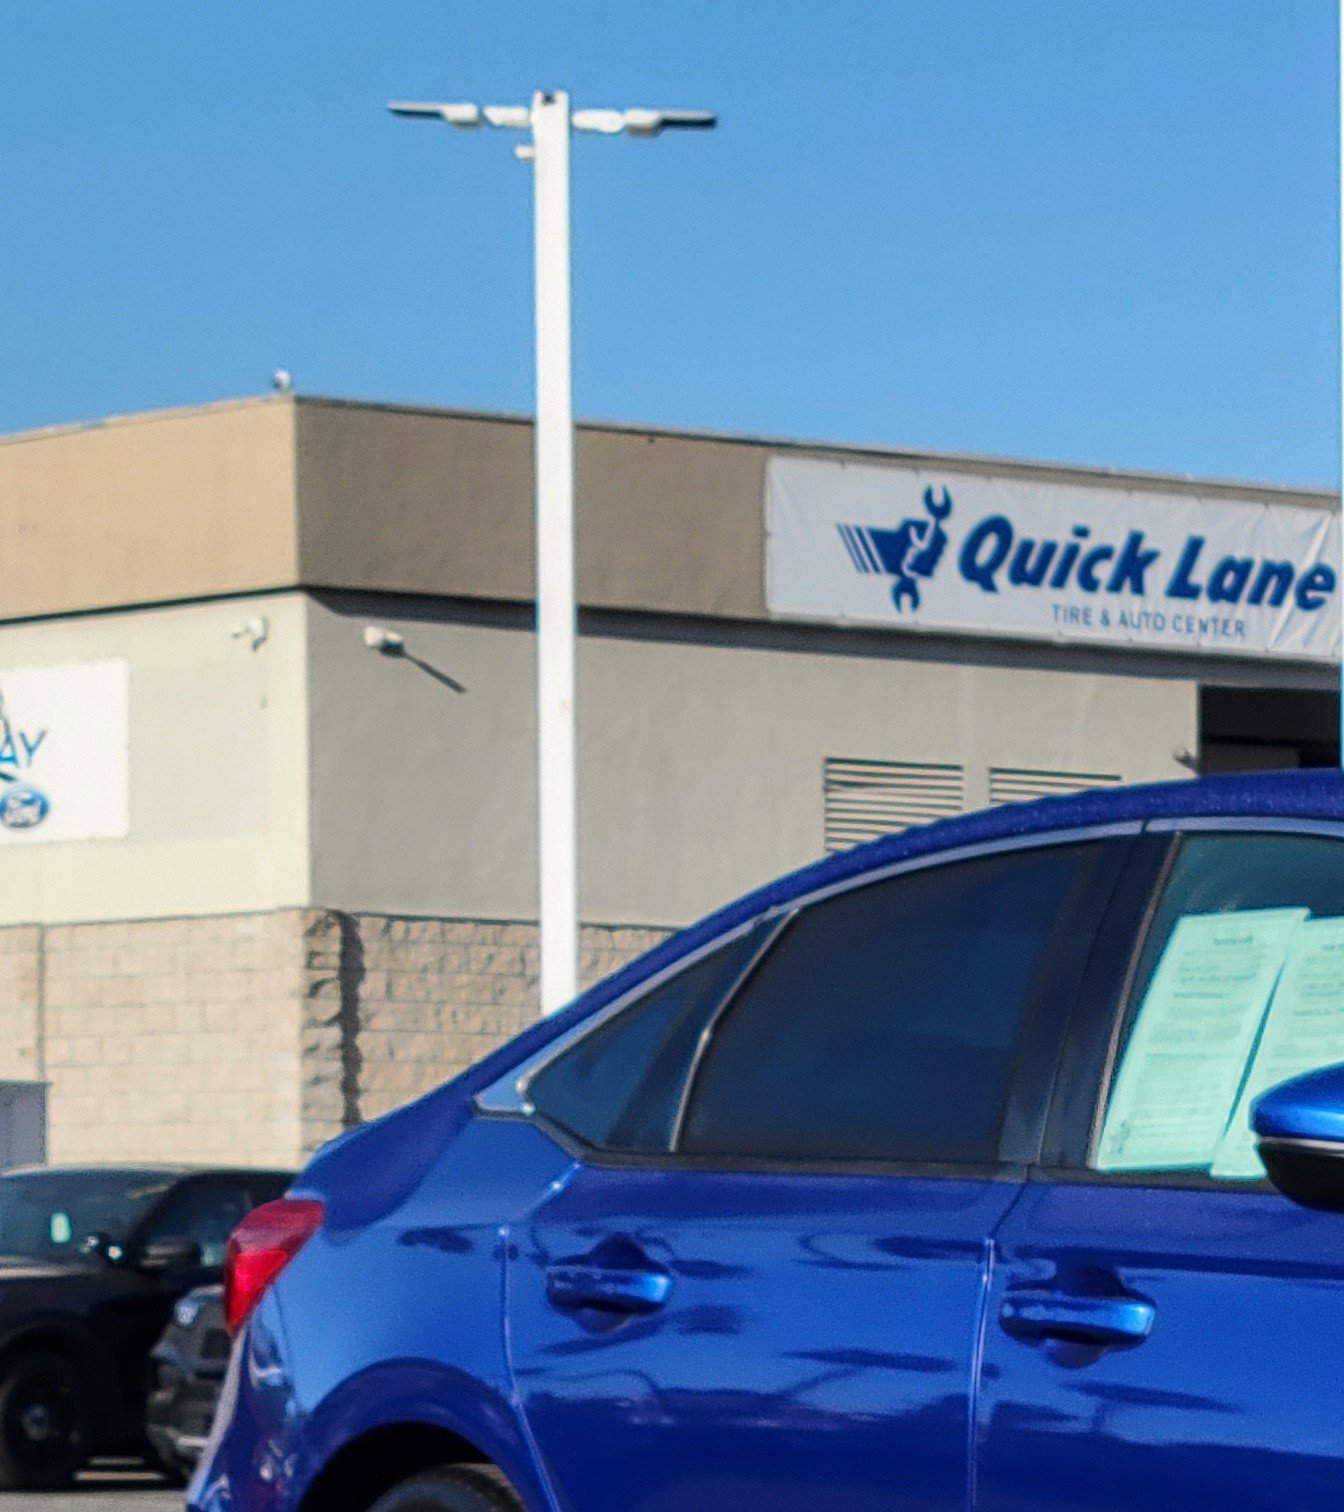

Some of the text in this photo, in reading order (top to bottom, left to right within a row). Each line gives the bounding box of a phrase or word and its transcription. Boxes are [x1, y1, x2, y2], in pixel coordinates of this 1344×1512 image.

[957, 514, 1337, 611] Quick Lane
[1052, 604, 1246, 637] TIRE & AUTO CENTER
